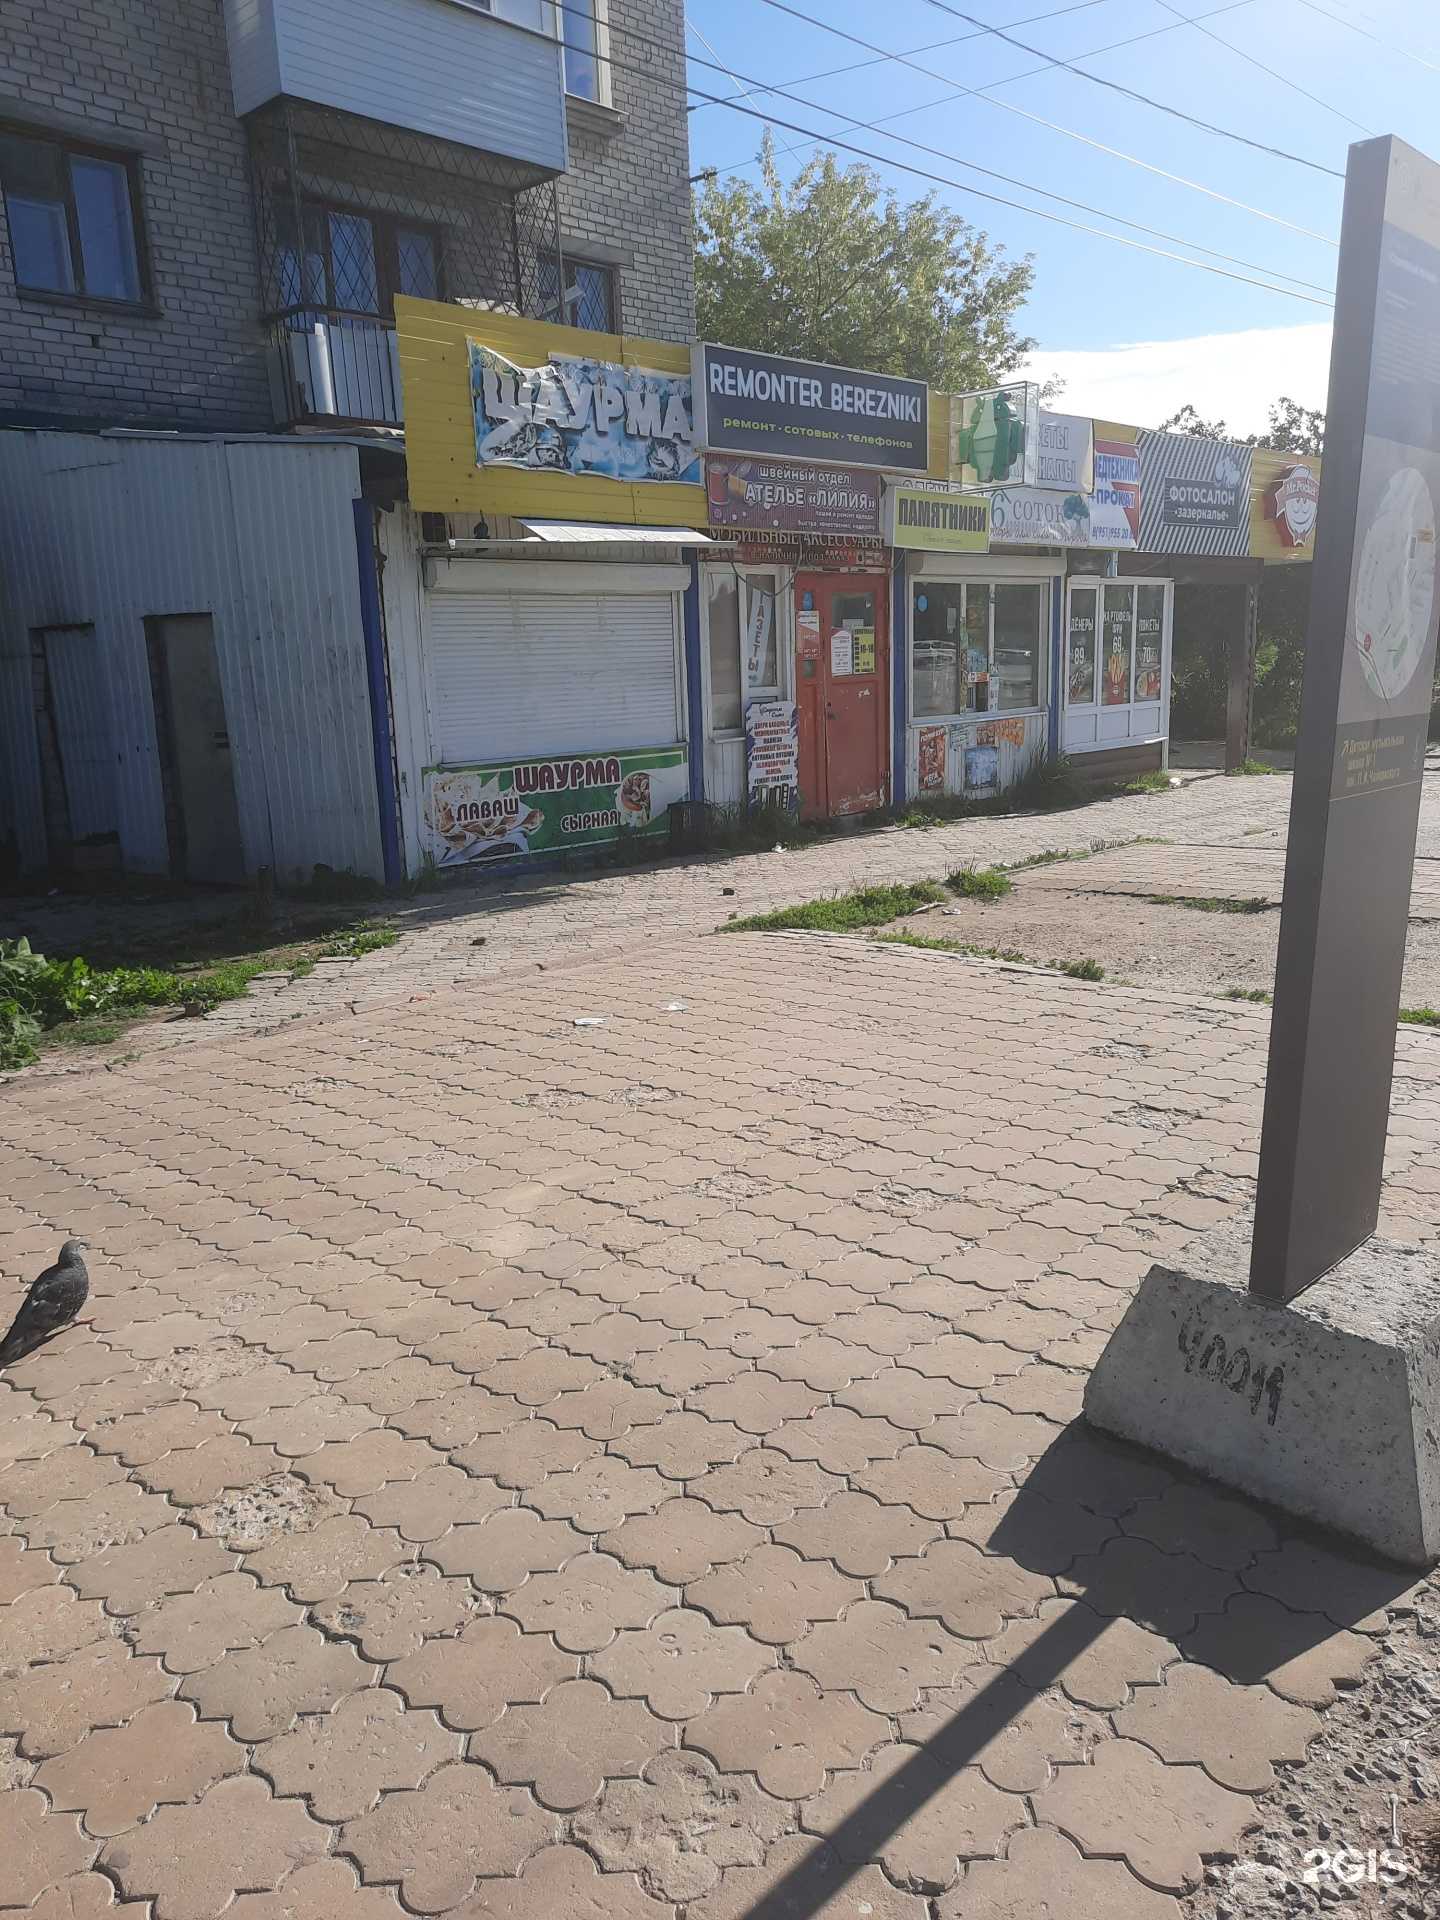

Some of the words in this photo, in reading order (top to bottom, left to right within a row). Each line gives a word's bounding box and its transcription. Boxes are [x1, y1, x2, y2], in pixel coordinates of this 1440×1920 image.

[483, 365, 695, 443] ШАУРМА
[723, 416, 777, 433] ремонт
[784, 425, 839, 440] сотовых
[847, 432, 914, 450] телефонов
[759, 463, 816, 482] швейный
[818, 473, 850, 485] отдел
[745, 484, 805, 506] АТЕЛЬЕ
[808, 489, 875, 511] «ЛИЛИЯ»
[991, 493, 1006, 528] 6
[1013, 500, 1066, 523] СОТОК
[1170, 485, 1236, 507] ФОТОСАЛОН
[898, 498, 987, 533] ПАМЯТНИКИ
[515, 758, 621, 793] ШАУРМА
[456, 797, 519, 822] ЛАВАШ
[562, 811, 621, 832] СЫРНАЯ
